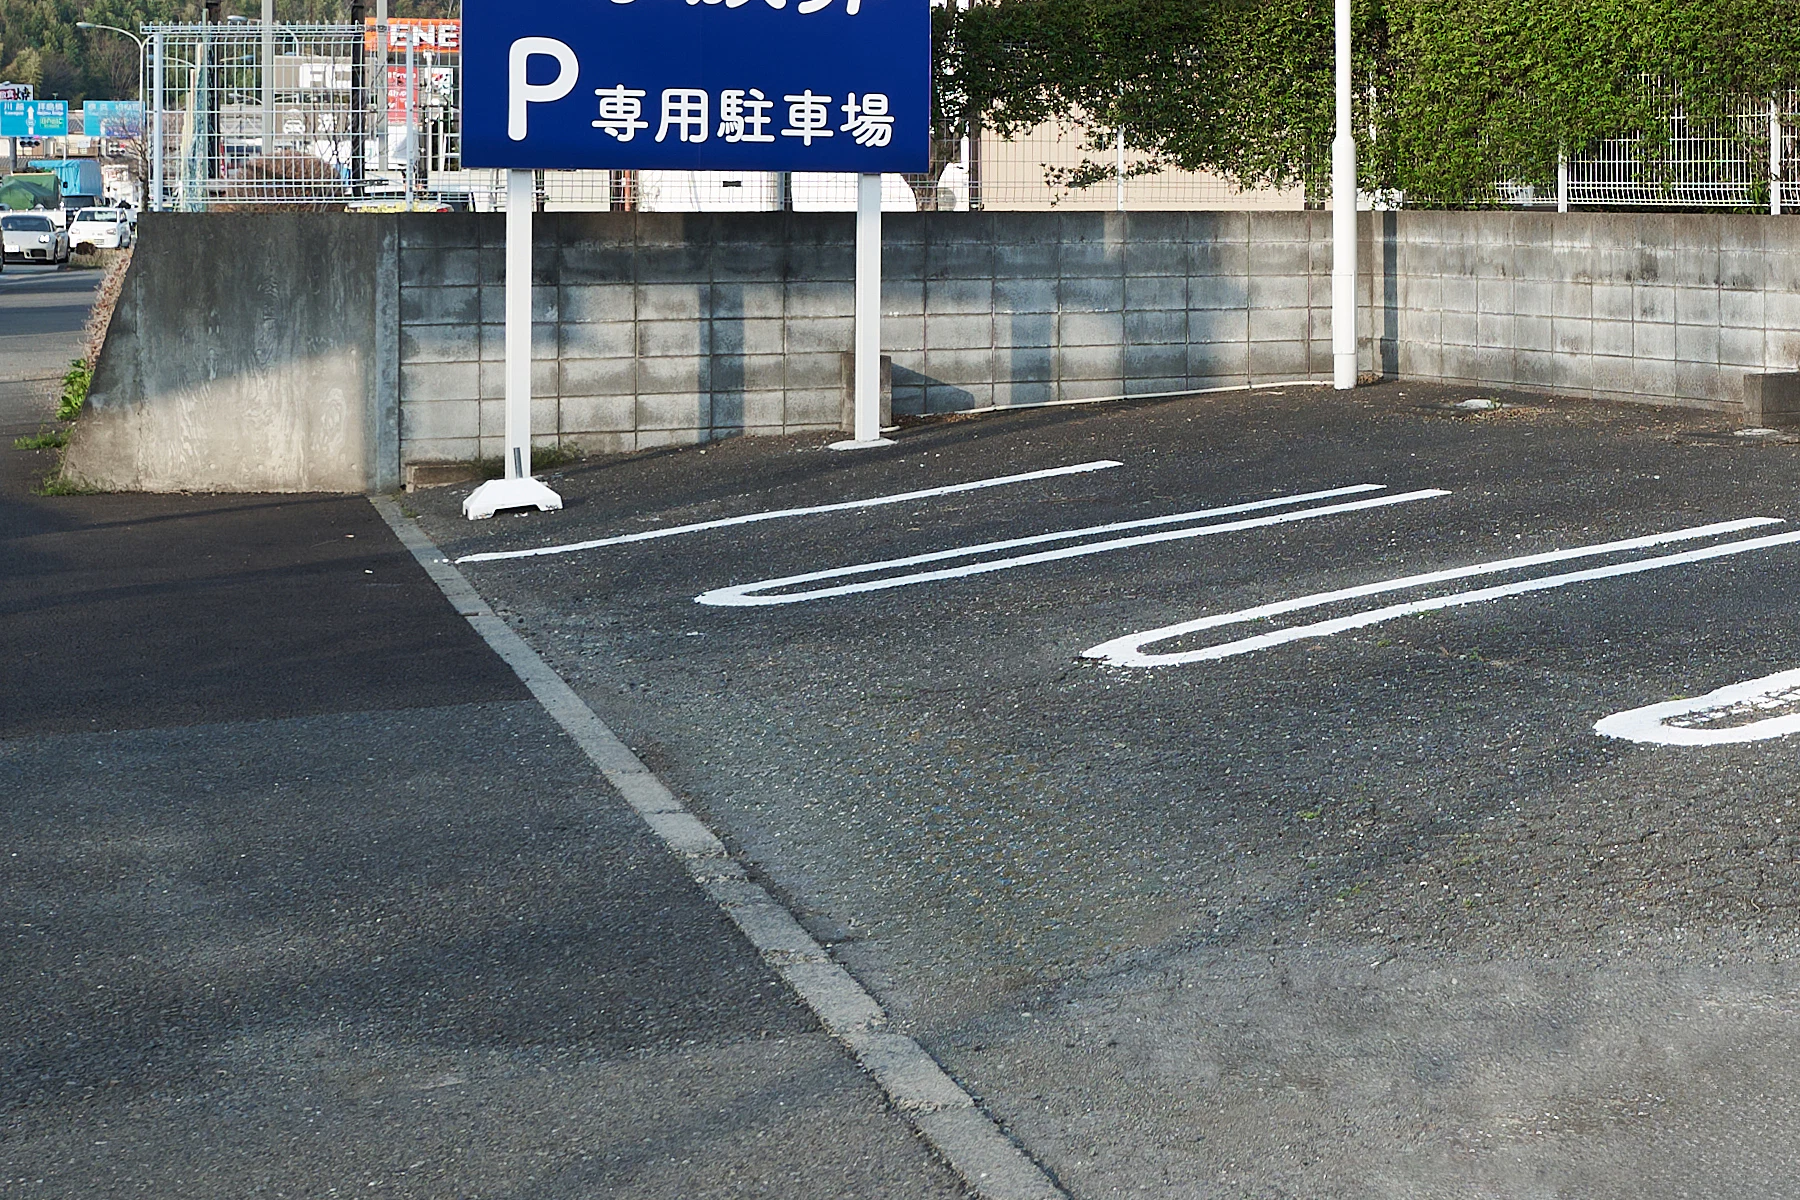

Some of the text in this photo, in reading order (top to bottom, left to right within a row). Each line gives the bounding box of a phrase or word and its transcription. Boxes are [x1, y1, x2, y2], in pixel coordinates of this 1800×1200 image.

[508, 37, 895, 148] P 専用駐車場
